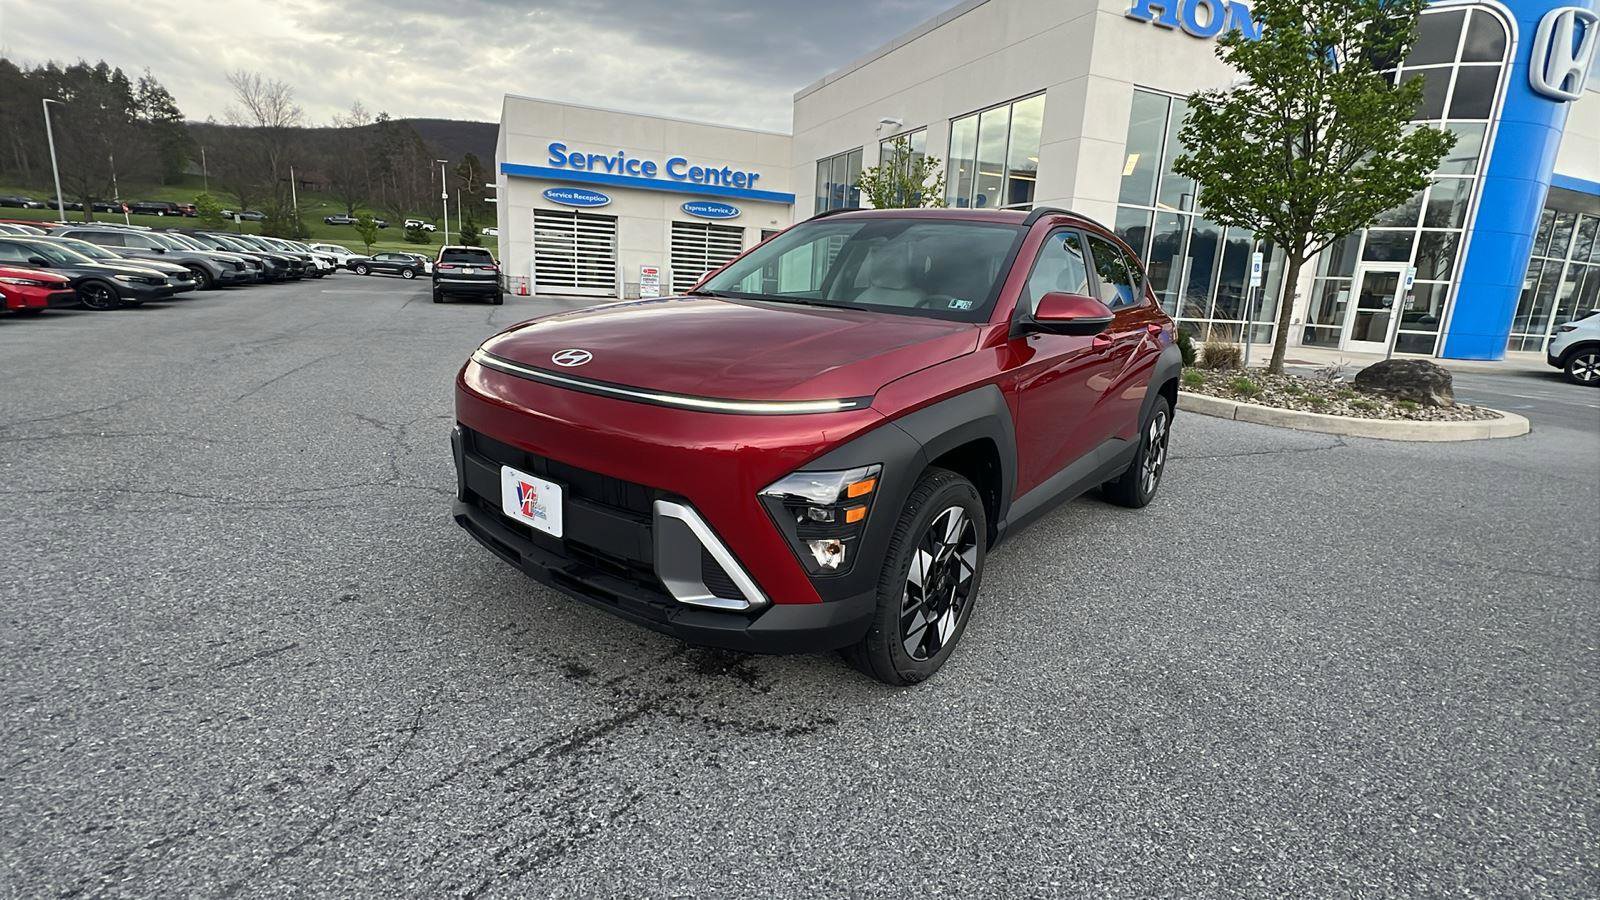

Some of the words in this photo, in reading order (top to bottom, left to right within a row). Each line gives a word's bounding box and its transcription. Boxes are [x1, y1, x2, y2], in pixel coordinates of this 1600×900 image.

[547, 142, 658, 177] Service
[666, 157, 760, 188] Center
[547, 190, 573, 199] Service
[573, 193, 607, 202] Reception
[684, 204, 707, 212] Express
[707, 206, 729, 214] Service
